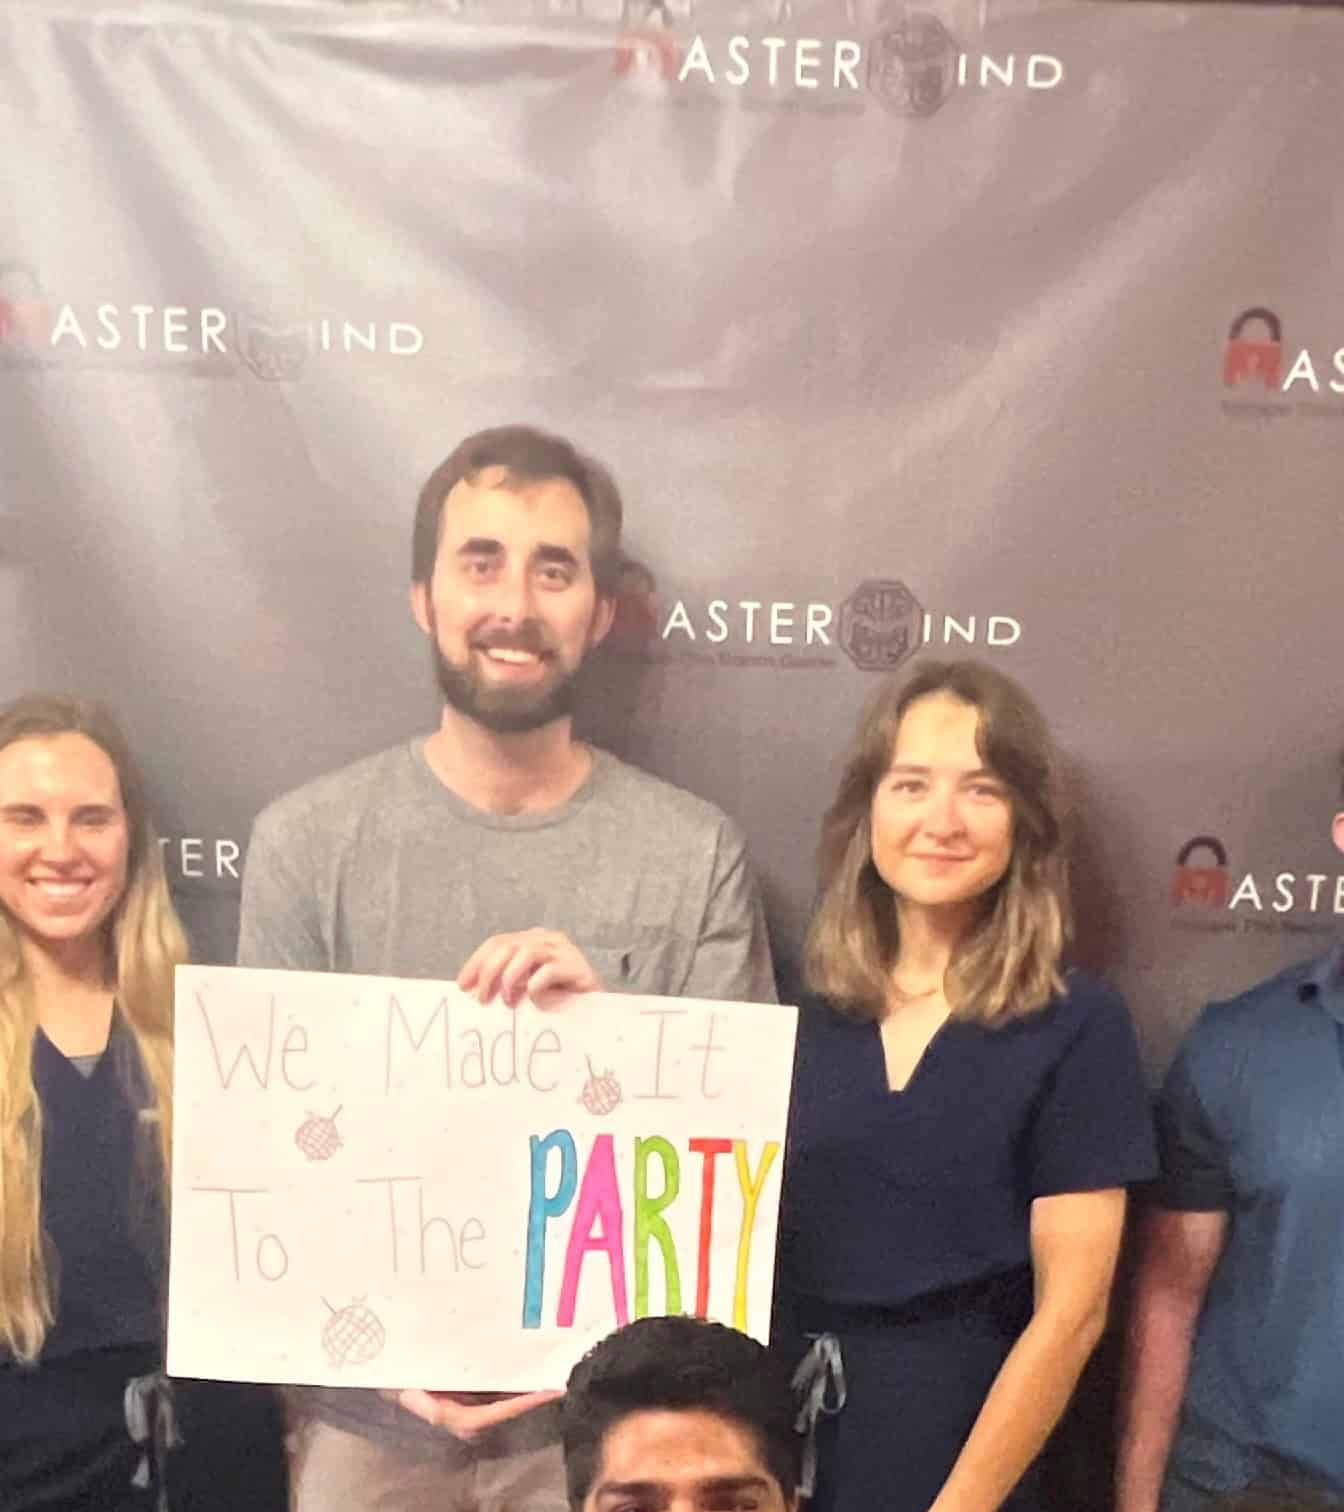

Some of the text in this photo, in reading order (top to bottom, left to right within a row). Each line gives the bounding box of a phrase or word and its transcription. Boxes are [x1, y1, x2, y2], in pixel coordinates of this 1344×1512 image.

[195, 991, 724, 1100] We Made It
[192, 1128, 781, 1331] To The PARTY
